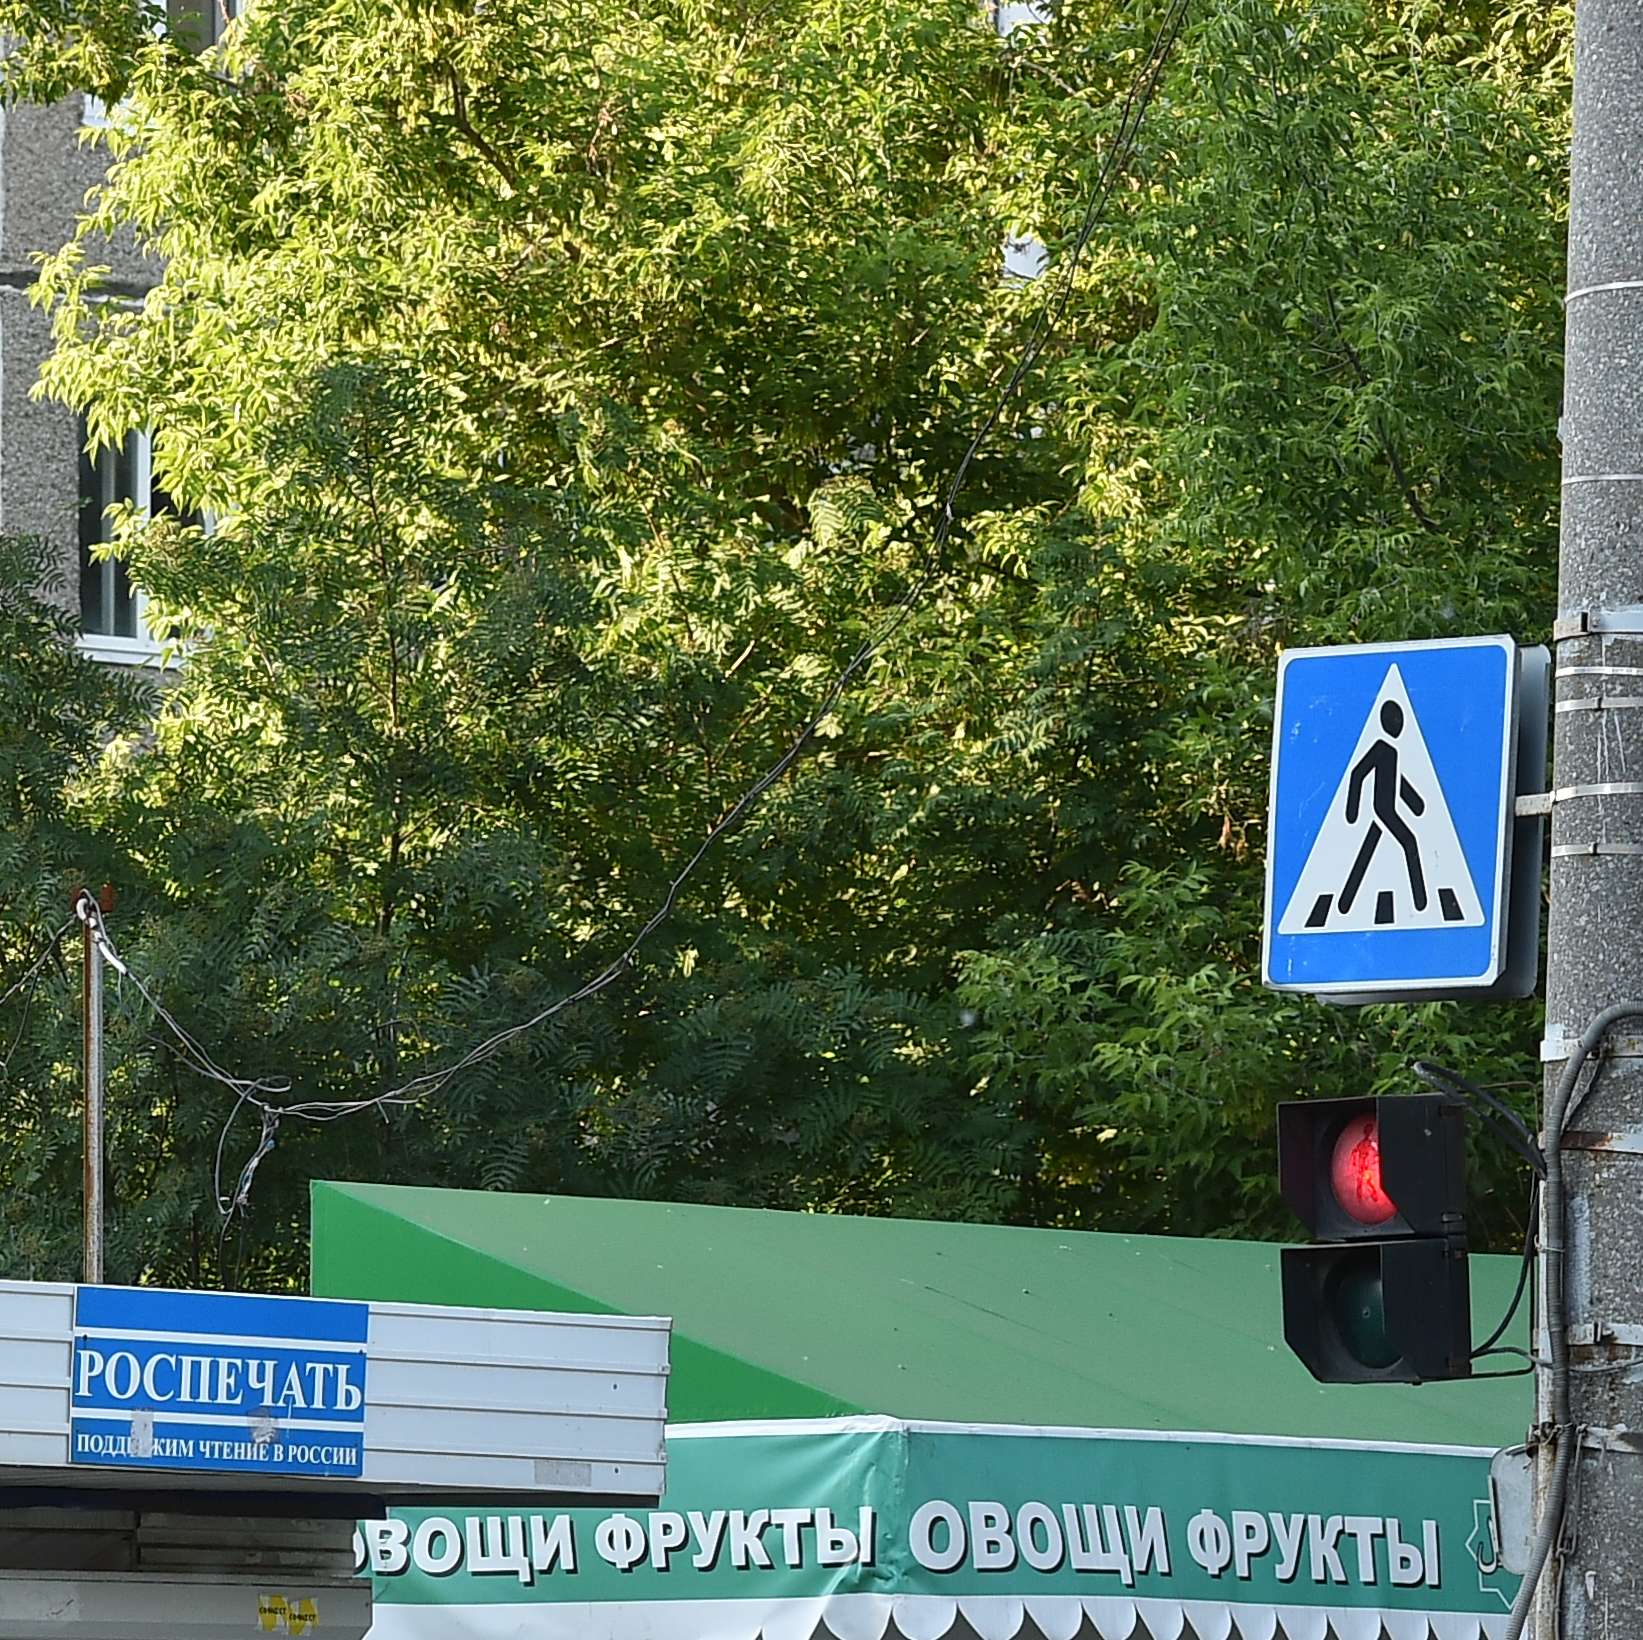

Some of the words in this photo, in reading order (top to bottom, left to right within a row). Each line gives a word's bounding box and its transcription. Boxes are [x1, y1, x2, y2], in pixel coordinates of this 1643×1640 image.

[75, 1349, 362, 1410] РОСПЕЧАТЬ
[76, 1434, 194, 1458] ПОДДЖИМ
[199, 1439, 269, 1461] ЧТЕНИЕ
[273, 1445, 284, 1462] В
[288, 1446, 358, 1466] РОССИИ
[595, 1505, 875, 1570] ФРУКТЫ
[909, 1500, 1171, 1586] ОВОЩИ
[1187, 1508, 1442, 1587] ФРУКТЫ
